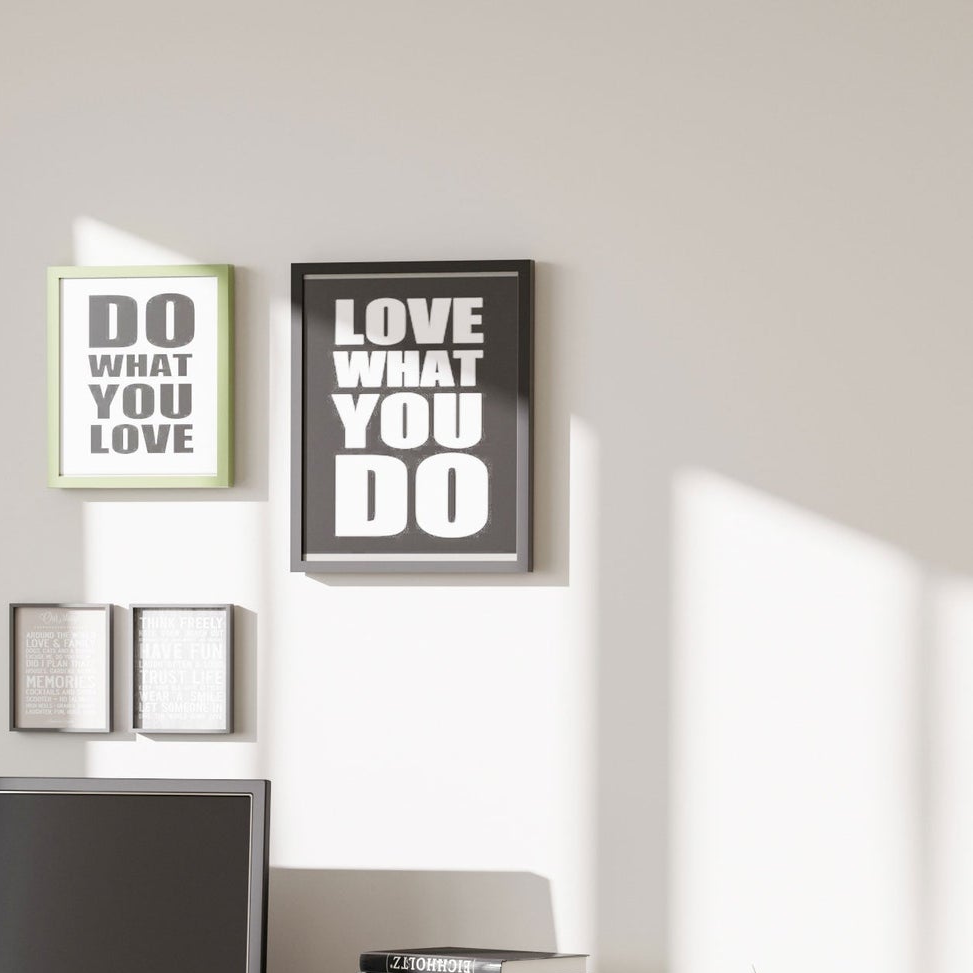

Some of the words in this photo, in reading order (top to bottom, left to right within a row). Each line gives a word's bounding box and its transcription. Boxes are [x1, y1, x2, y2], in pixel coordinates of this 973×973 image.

[88, 293, 195, 349] DO
[335, 297, 484, 346] LOVE
[88, 353, 193, 378] WHAT
[332, 350, 484, 388] WHAT
[88, 383, 193, 419] YOU
[331, 392, 483, 450] YOU
[90, 423, 194, 455] LOVE
[335, 452, 489, 539] DO
[139, 617, 175, 629] THINK
[180, 617, 223, 629] FREELY
[26, 631, 55, 639] AROUND
[26, 639, 50, 648] LOVE
[52, 639, 60, 648] &
[139, 643, 182, 659] HAVE
[191, 643, 223, 660] FUN
[26, 660, 39, 668] DID
[47, 660, 68, 669] PLAN
[26, 676, 97, 689] MEMORIES
[139, 669, 186, 685] TRUST
[193, 670, 223, 685] LIFE
[138, 690, 169, 702] WEAR
[190, 690, 223, 702] SMILE
[161, 702, 209, 713] SOMEONE
[212, 702, 223, 713] IN
[390, 956, 472, 973] EICHHOLTZ
